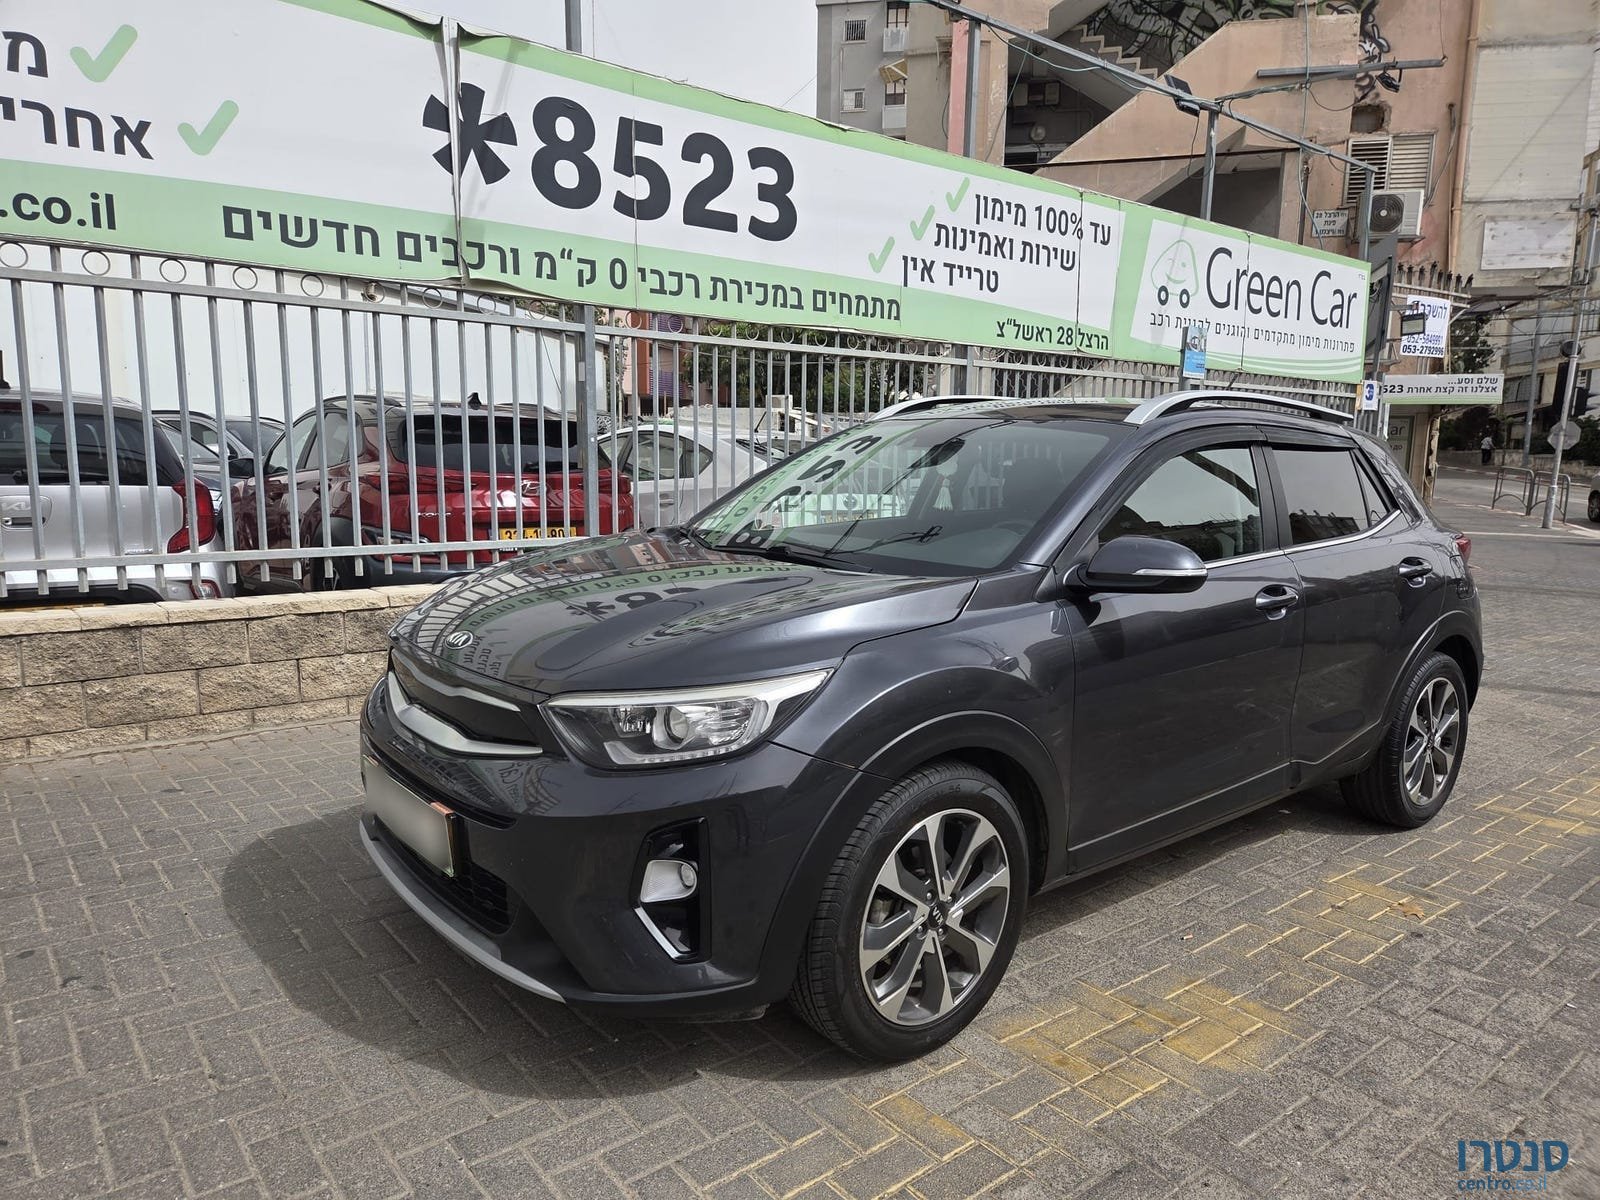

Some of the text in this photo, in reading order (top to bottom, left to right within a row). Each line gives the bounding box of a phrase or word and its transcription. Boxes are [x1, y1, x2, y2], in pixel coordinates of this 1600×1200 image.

[0, 192, 117, 231] .co.il
[975, 193, 1111, 247] עד 100% מימון
[221, 205, 380, 259] חדשים
[396, 230, 520, 277] ורכבים
[934, 222, 1077, 272] שירות ואמינות
[609, 257, 628, 290] 0
[637, 267, 700, 299] רכבי
[902, 255, 1000, 293] טרייד אין
[1206, 246, 1358, 329] Green Car
[708, 276, 805, 312] במכירת
[812, 289, 902, 322] מתמחים
[1149, 312, 1171, 328] רכב
[1056, 325, 1074, 346] 28
[1077, 327, 1109, 351] הרצל
[1253, 328, 1296, 347] מתקדמים
[1298, 334, 1321, 350] מימון
[1323, 338, 1356, 354] פתרונות
[1406, 385, 1433, 393] אחרת
[1434, 385, 1455, 395] קצת
[1457, 385, 1469, 393] זה
[1473, 384, 1498, 393] אצלנו
[1476, 375, 1499, 385] שלם
